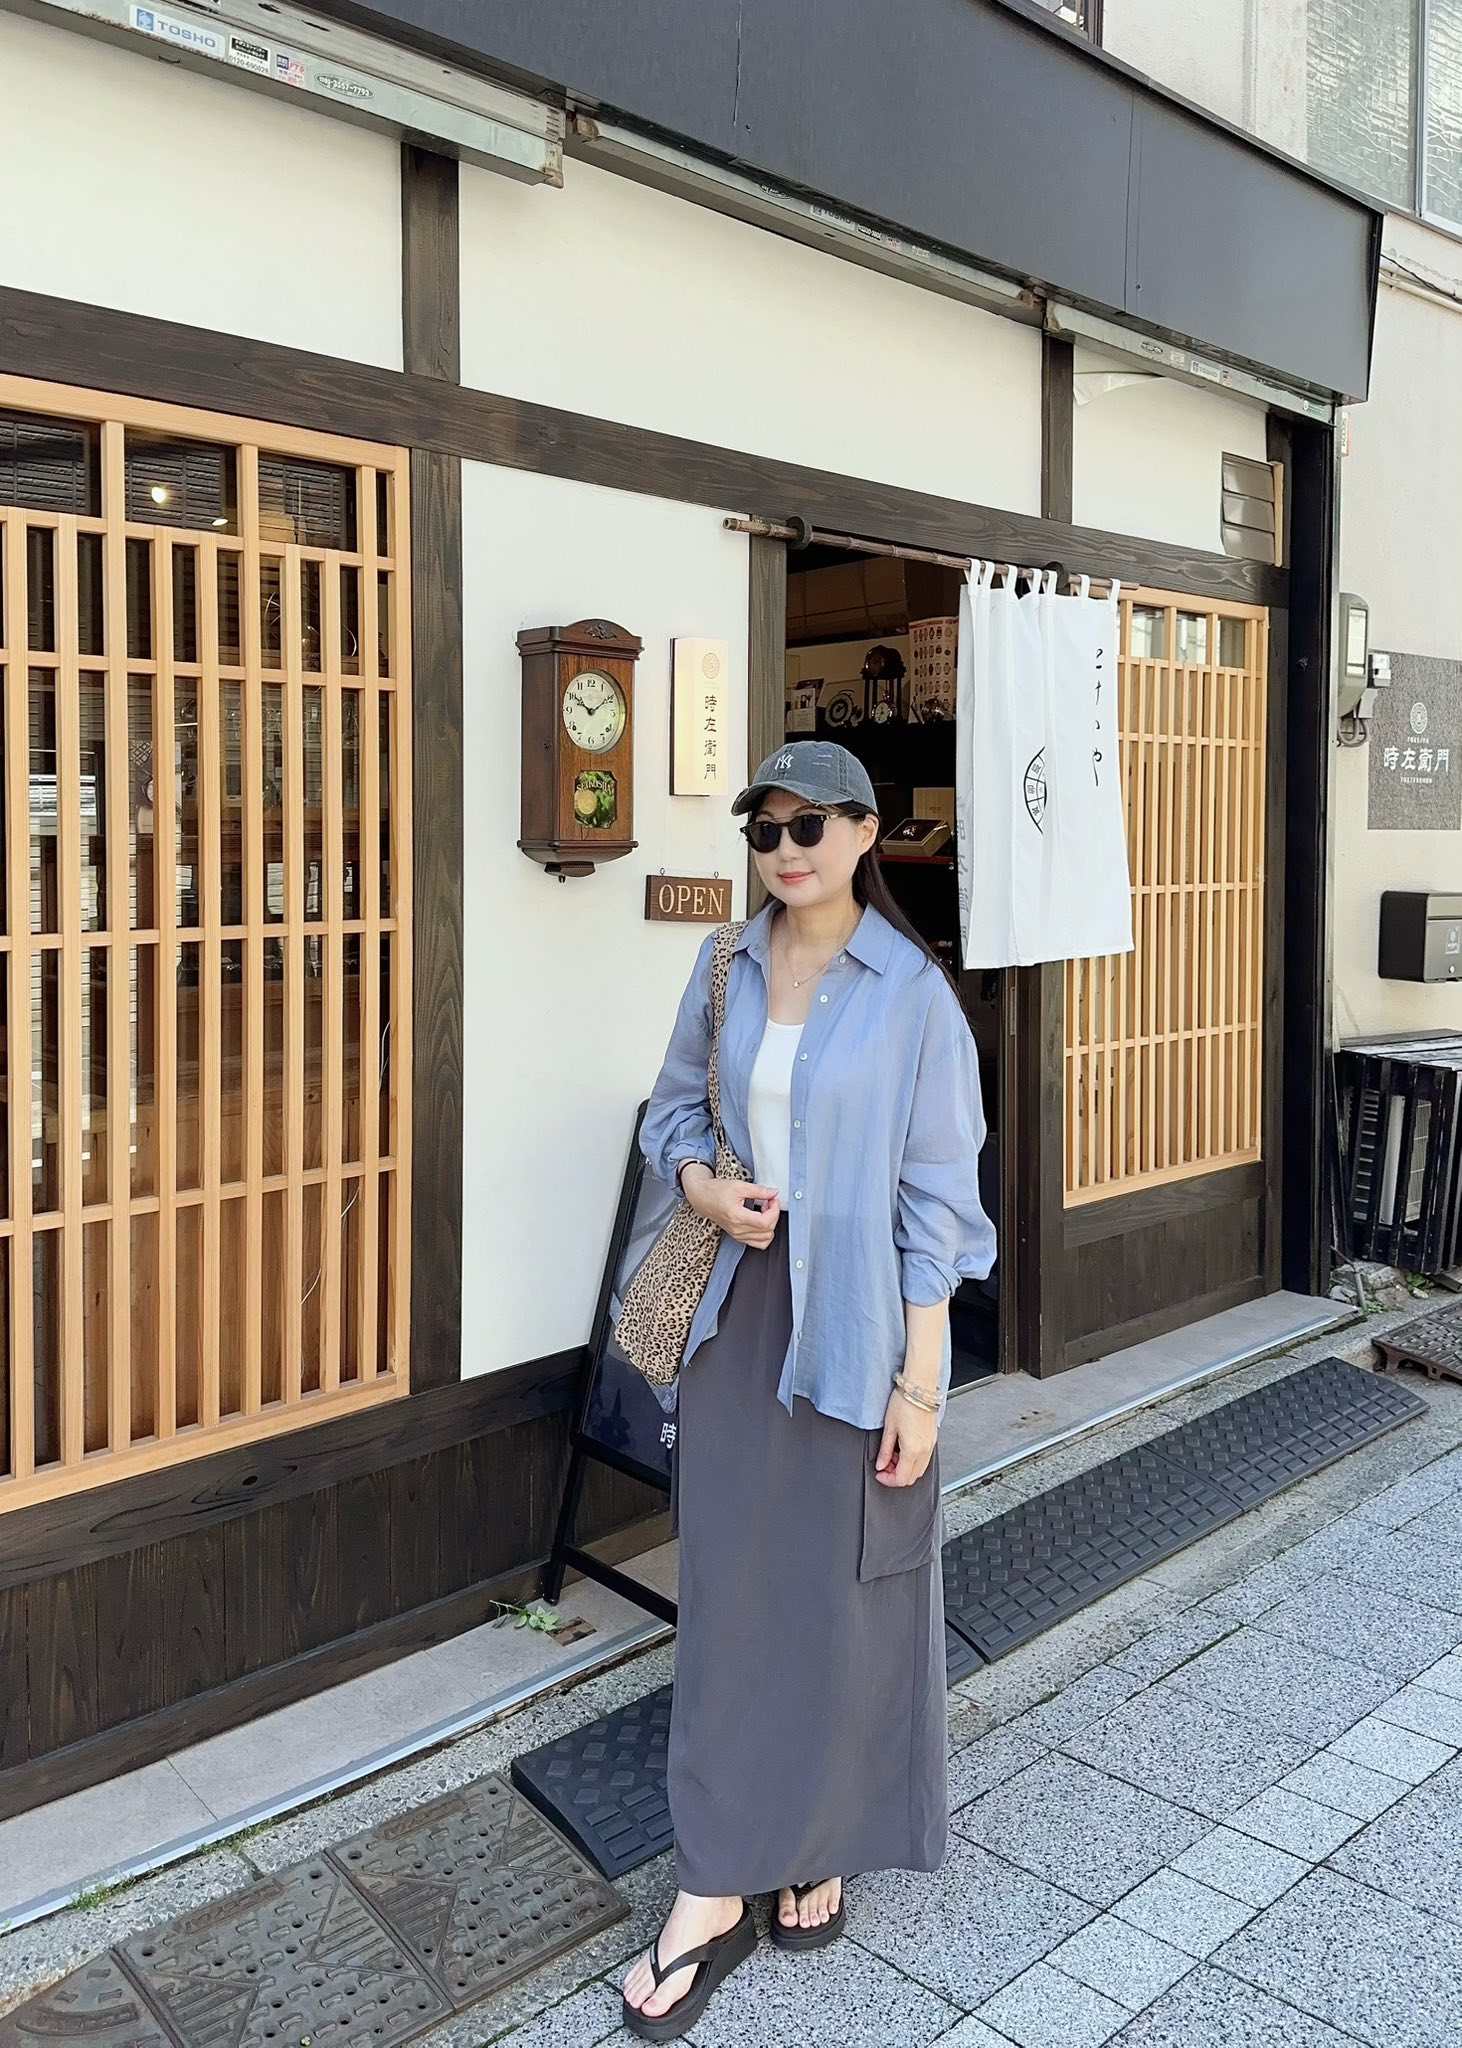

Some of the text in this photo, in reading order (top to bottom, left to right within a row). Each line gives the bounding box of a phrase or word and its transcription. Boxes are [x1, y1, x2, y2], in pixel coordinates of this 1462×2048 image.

[157, 20, 216, 48] TOSHO
[577, 682, 583, 690] 11
[587, 679, 596, 688] 12
[565, 706, 573, 714] 9
[774, 753, 794, 771] NY
[1383, 745, 1449, 773] 時左衛門
[659, 884, 725, 916] OPEN
